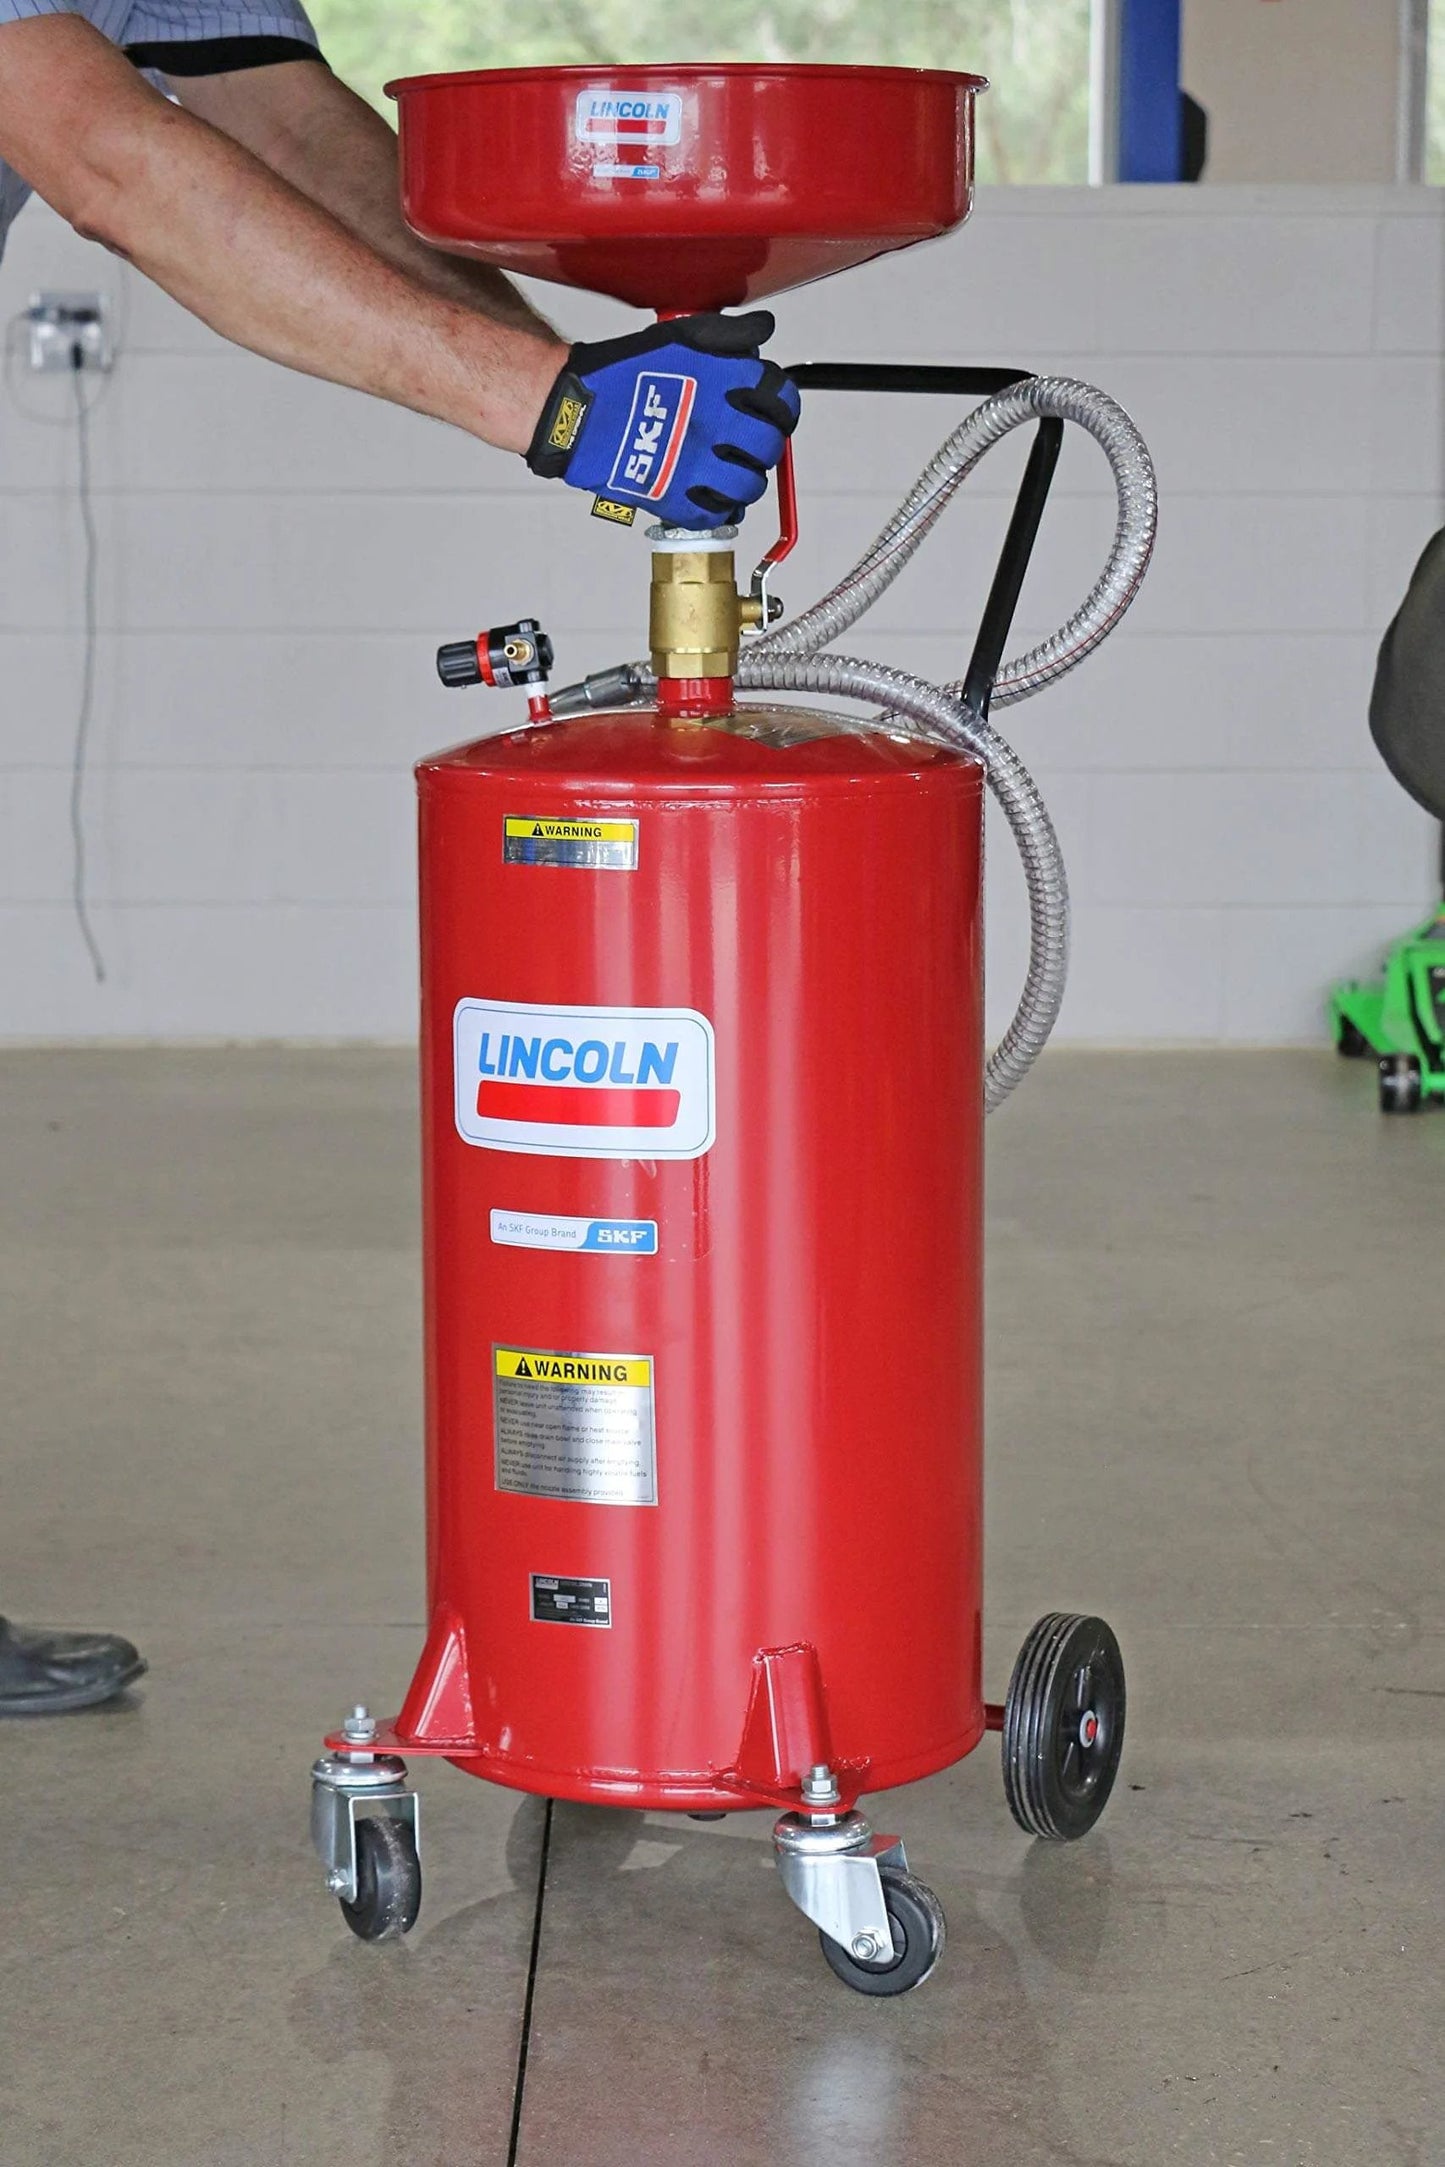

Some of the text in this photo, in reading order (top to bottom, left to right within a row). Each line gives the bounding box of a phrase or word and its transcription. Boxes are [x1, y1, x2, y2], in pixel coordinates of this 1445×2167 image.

[590, 101, 670, 119] LINCOLN
[624, 384, 668, 485] SKF
[545, 825, 602, 837] WARNING
[478, 1032, 679, 1084] LINCOLN
[498, 1222, 577, 1239] An SKF Group Brand
[597, 1229, 648, 1244] SKF
[534, 1360, 627, 1381] WARNING
